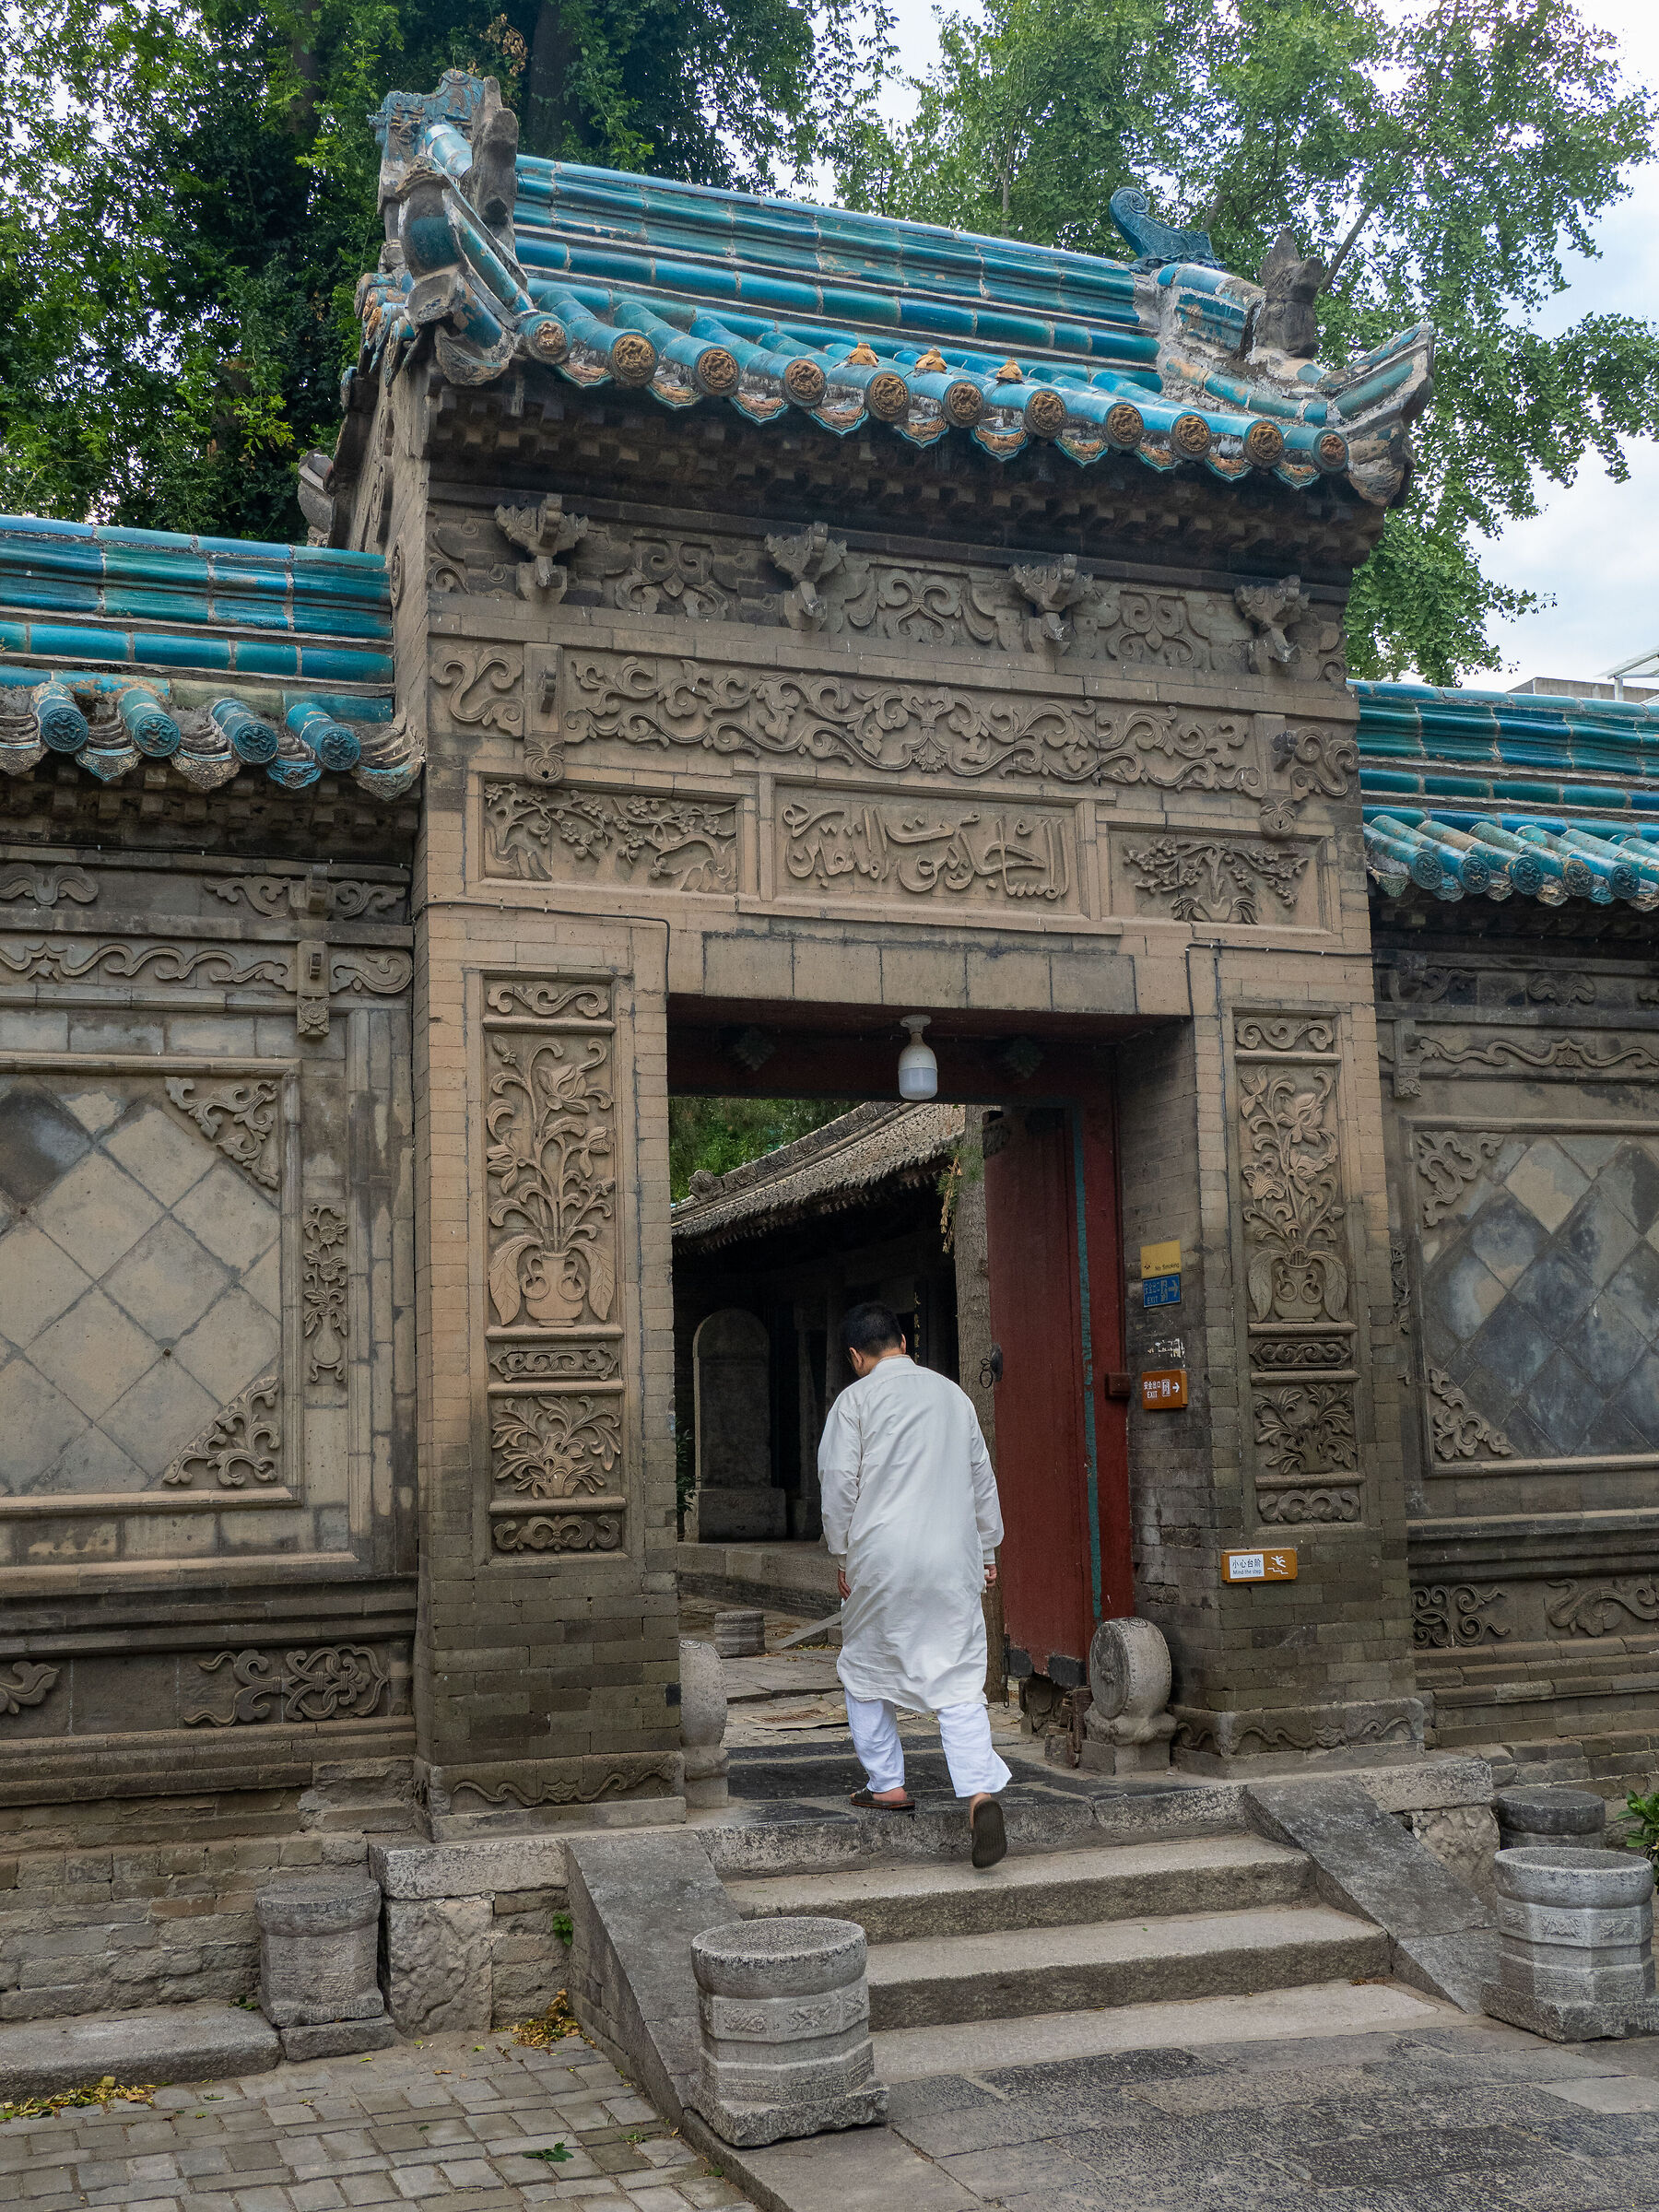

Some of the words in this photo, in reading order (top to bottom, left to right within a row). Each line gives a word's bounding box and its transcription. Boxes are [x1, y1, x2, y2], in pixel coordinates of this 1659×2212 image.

[1147, 1296, 1159, 1304] EXIT
[1144, 1381, 1160, 1390] 安全出口
